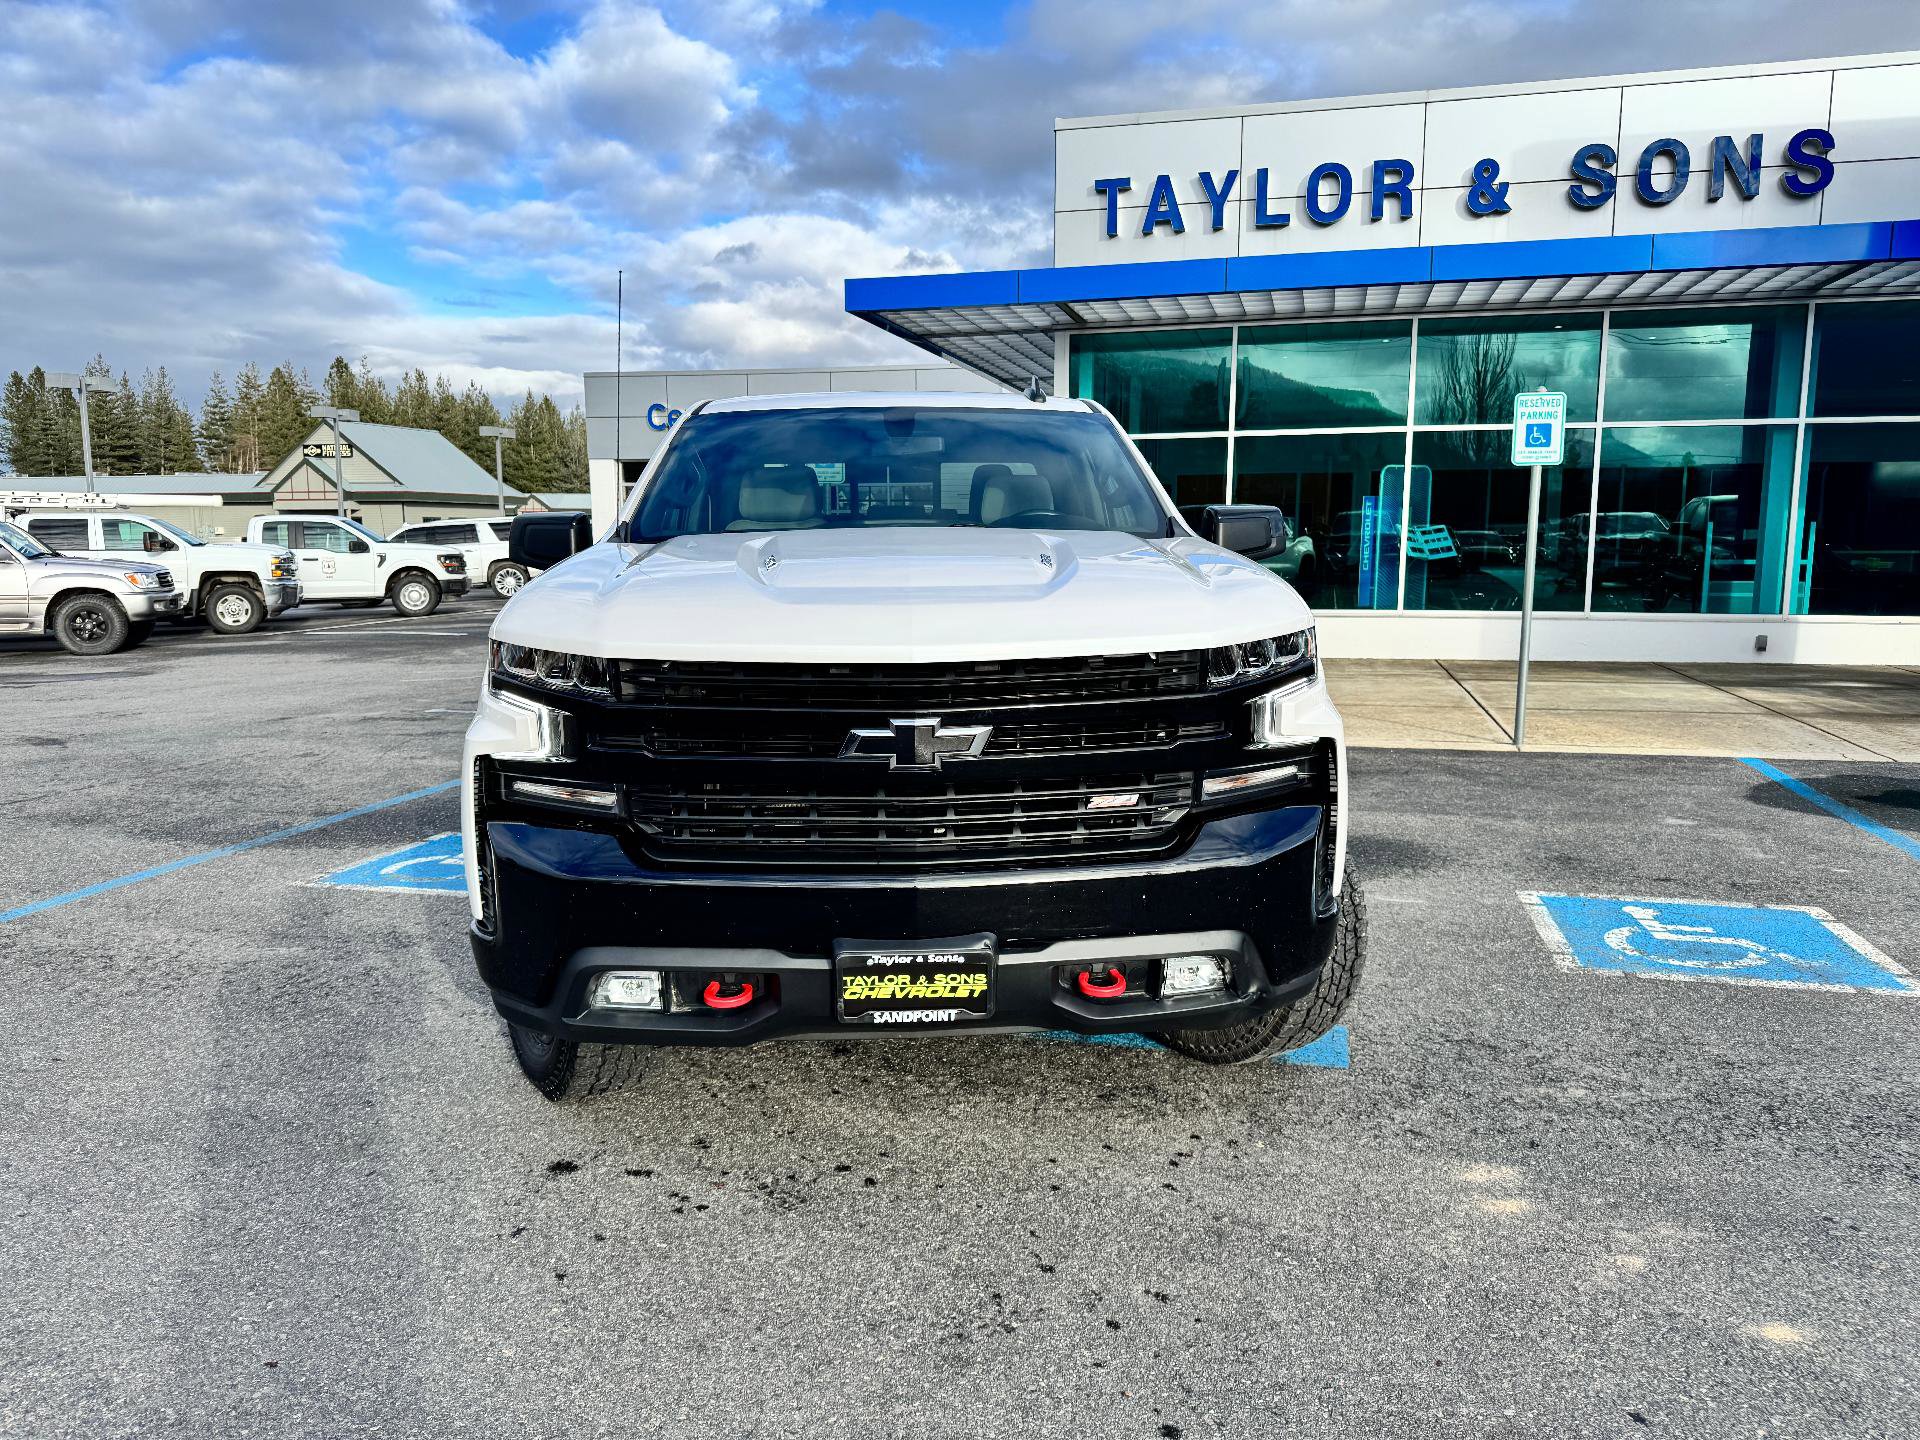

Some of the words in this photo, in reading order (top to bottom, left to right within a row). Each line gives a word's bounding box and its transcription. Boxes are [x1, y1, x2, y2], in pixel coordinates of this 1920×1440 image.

[1094, 158, 1416, 238] TAYLOR
[1466, 157, 1512, 216] &
[1568, 127, 1837, 211] SONS
[1519, 398, 1561, 408] RESERVED
[1520, 410, 1559, 420] PARKING
[1363, 501, 1373, 571] CHEVROLET
[871, 955, 913, 966] Taylor
[927, 954, 959, 963] Sons
[843, 974, 911, 986] TAYLOR
[917, 975, 929, 986] &
[934, 973, 987, 985] SONS
[843, 986, 988, 999] CHEVROLET
[873, 1010, 958, 1023] SANDPOINT
